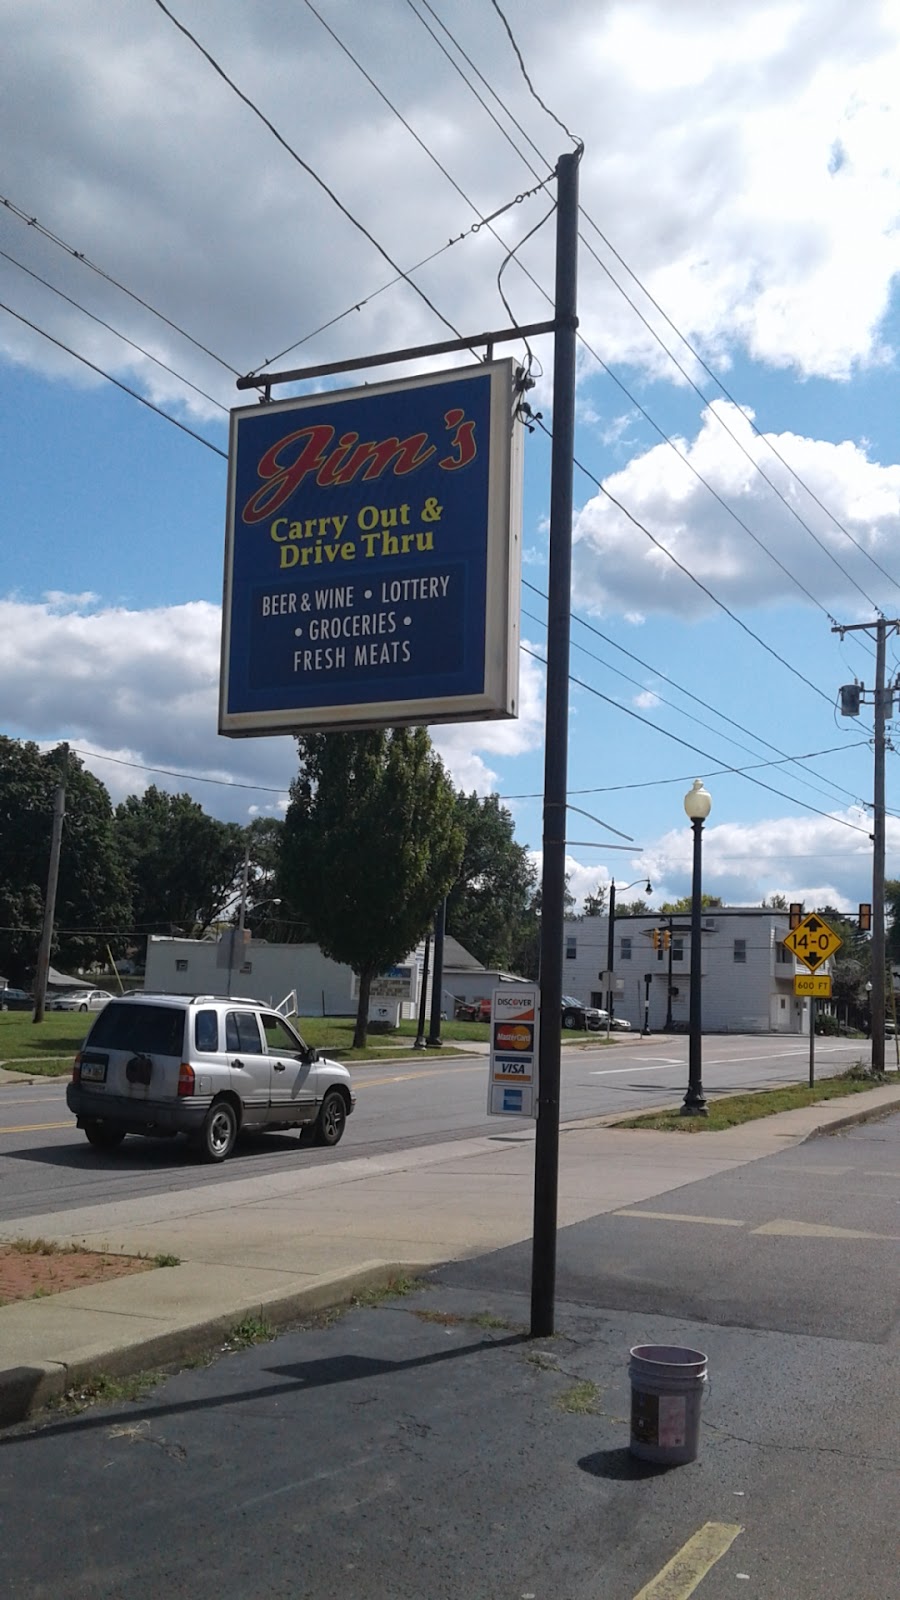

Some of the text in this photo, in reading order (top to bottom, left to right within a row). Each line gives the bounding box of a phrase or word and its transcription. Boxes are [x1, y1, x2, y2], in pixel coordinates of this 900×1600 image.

[242, 408, 477, 524] Jim's
[270, 497, 443, 542] Carry Out &
[280, 530, 434, 568] Drive Thru
[262, 575, 450, 616] BEER & WINE LOTTERY
[309, 611, 396, 641] GROCERIES
[294, 640, 411, 672] FRESH MEATS
[797, 982, 828, 990] 600 FT
[497, 998, 532, 1007] DISCOVER
[497, 1033, 532, 1042] MasterCard
[501, 1063, 525, 1074] VISA
